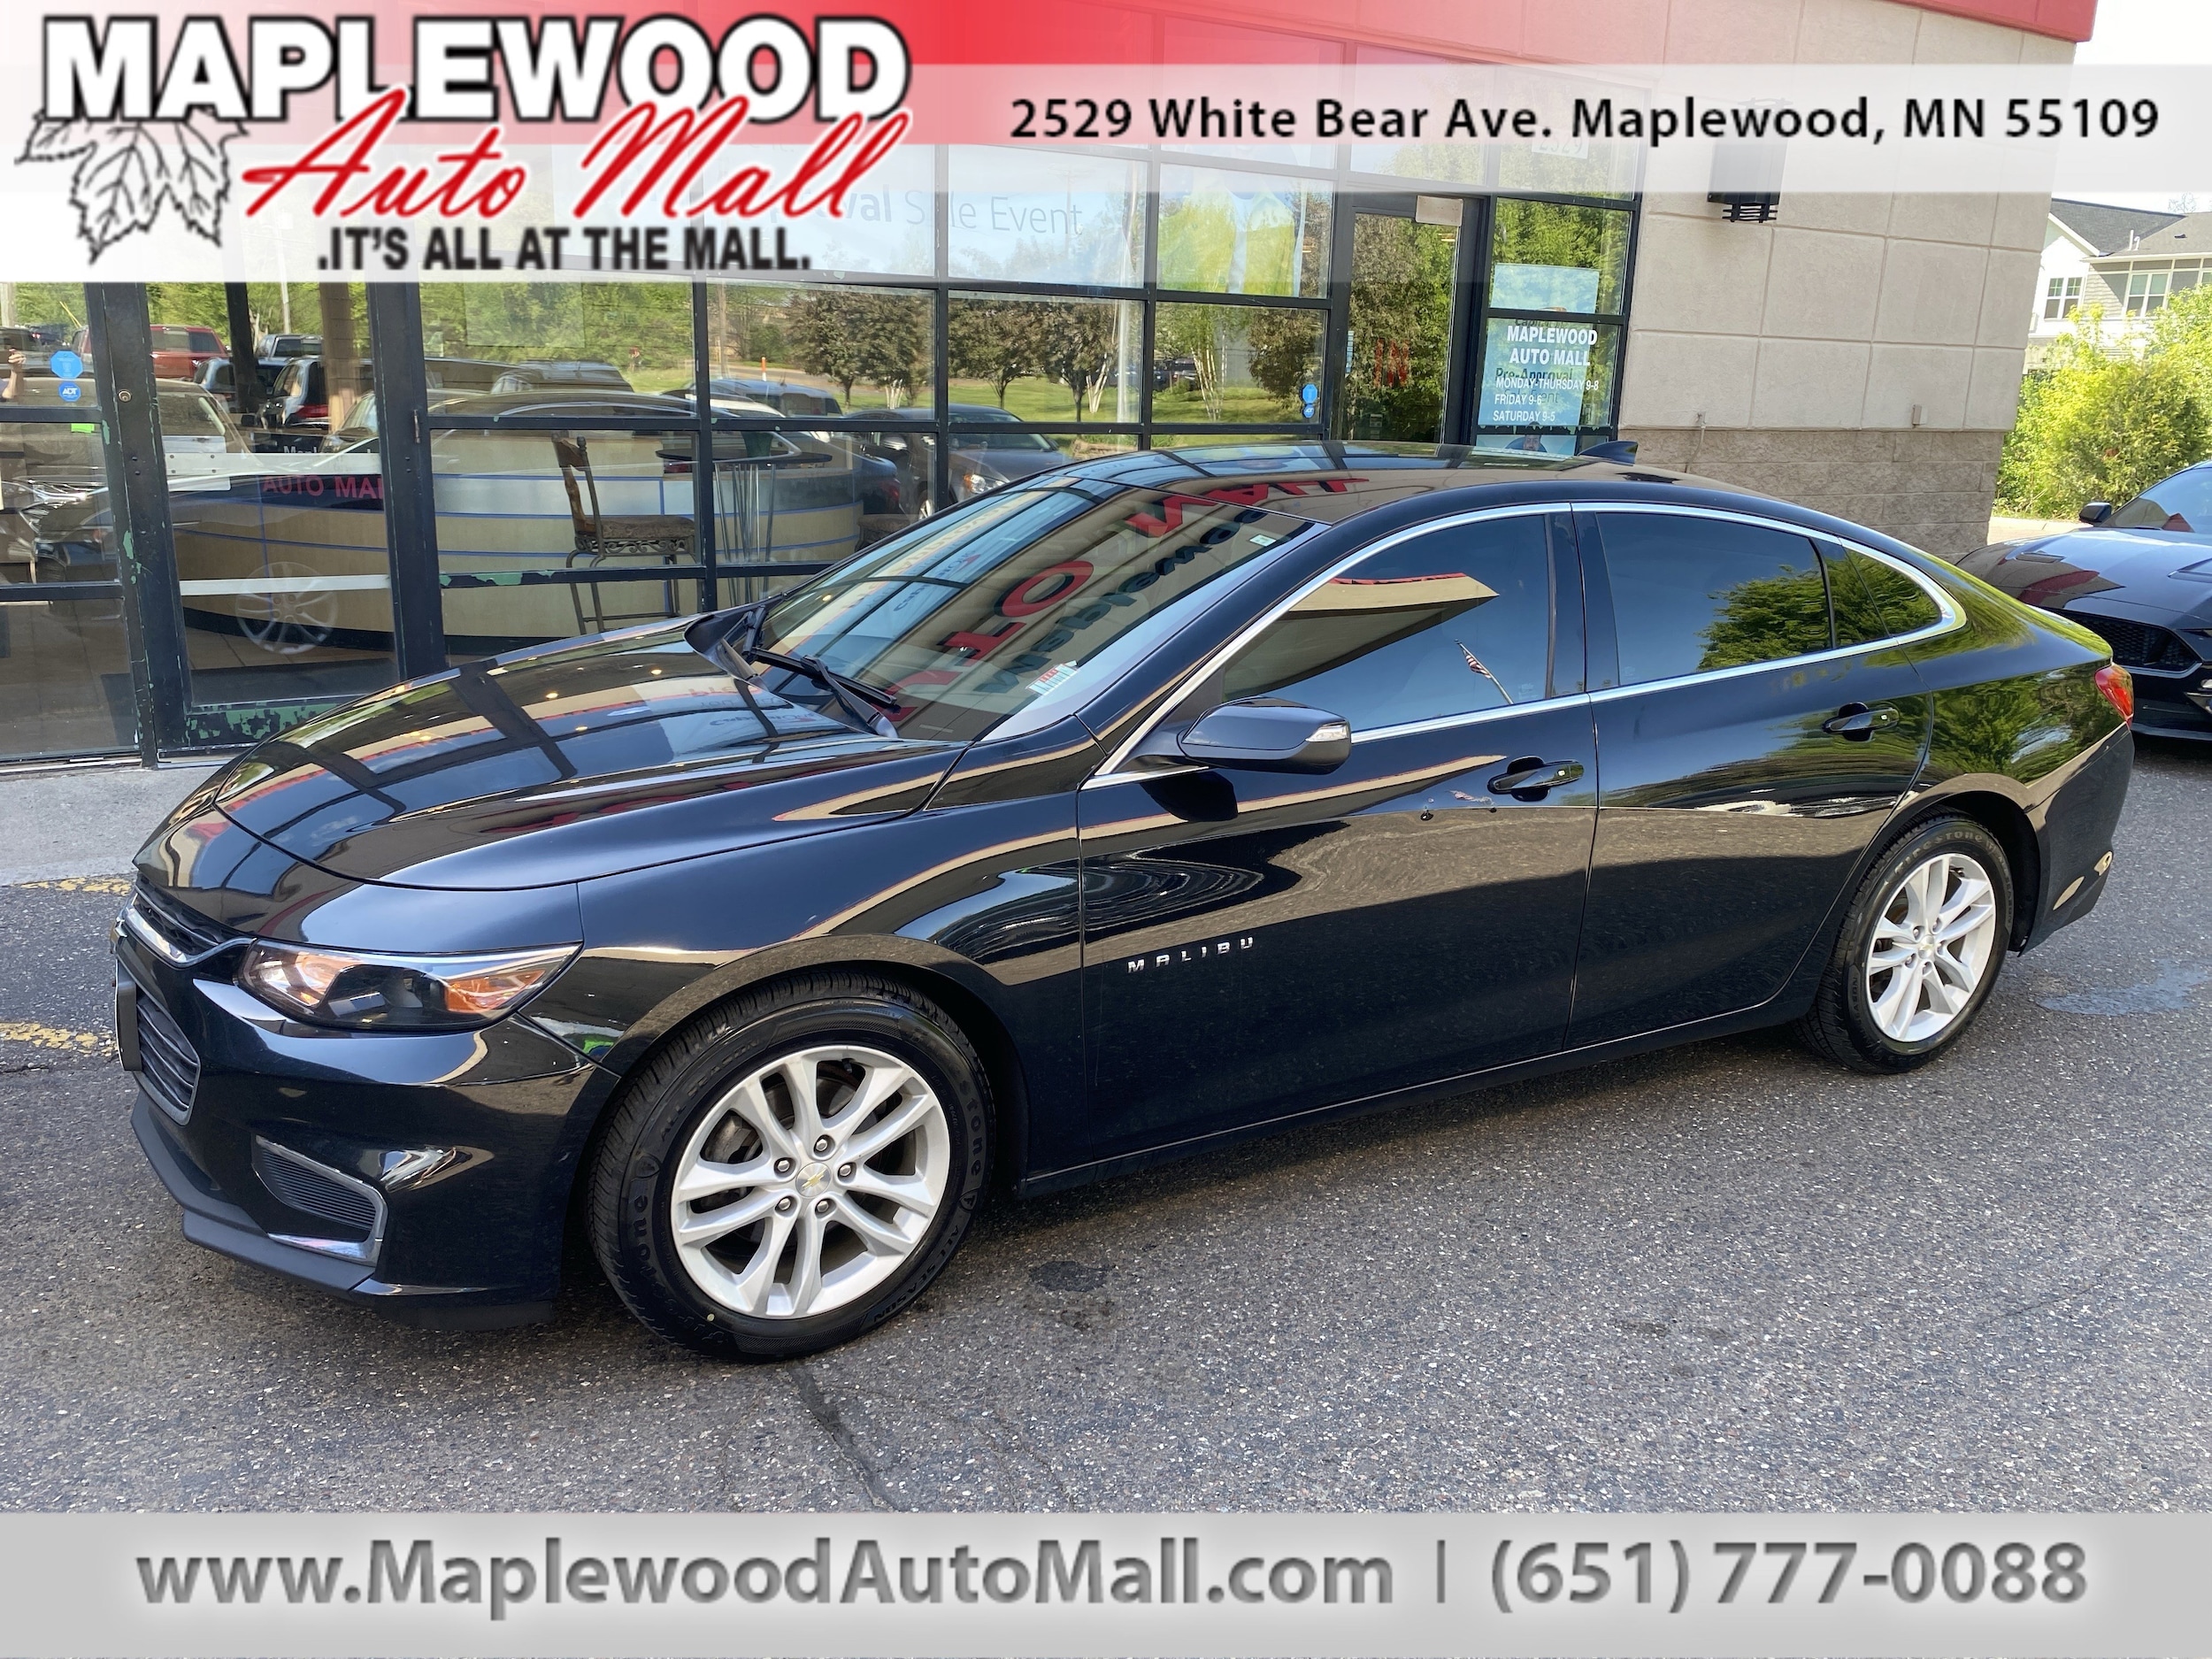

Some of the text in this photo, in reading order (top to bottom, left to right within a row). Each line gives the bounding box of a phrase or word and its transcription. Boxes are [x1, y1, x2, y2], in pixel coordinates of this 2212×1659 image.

[904, 189, 978, 230] Sle
[990, 196, 1083, 236] Event
[1507, 325, 1598, 346] MAPLEWOOD
[1509, 348, 1591, 366] AUTO MALL
[1495, 377, 1600, 391] MONDAY-THURSDAY 9-8
[1494, 394, 1542, 405] FRIDAY 9-6
[1493, 410, 1555, 422] SATURDAY 9-5
[263, 474, 324, 496] AUTO
[1127, 936, 1254, 973] MALIBU
